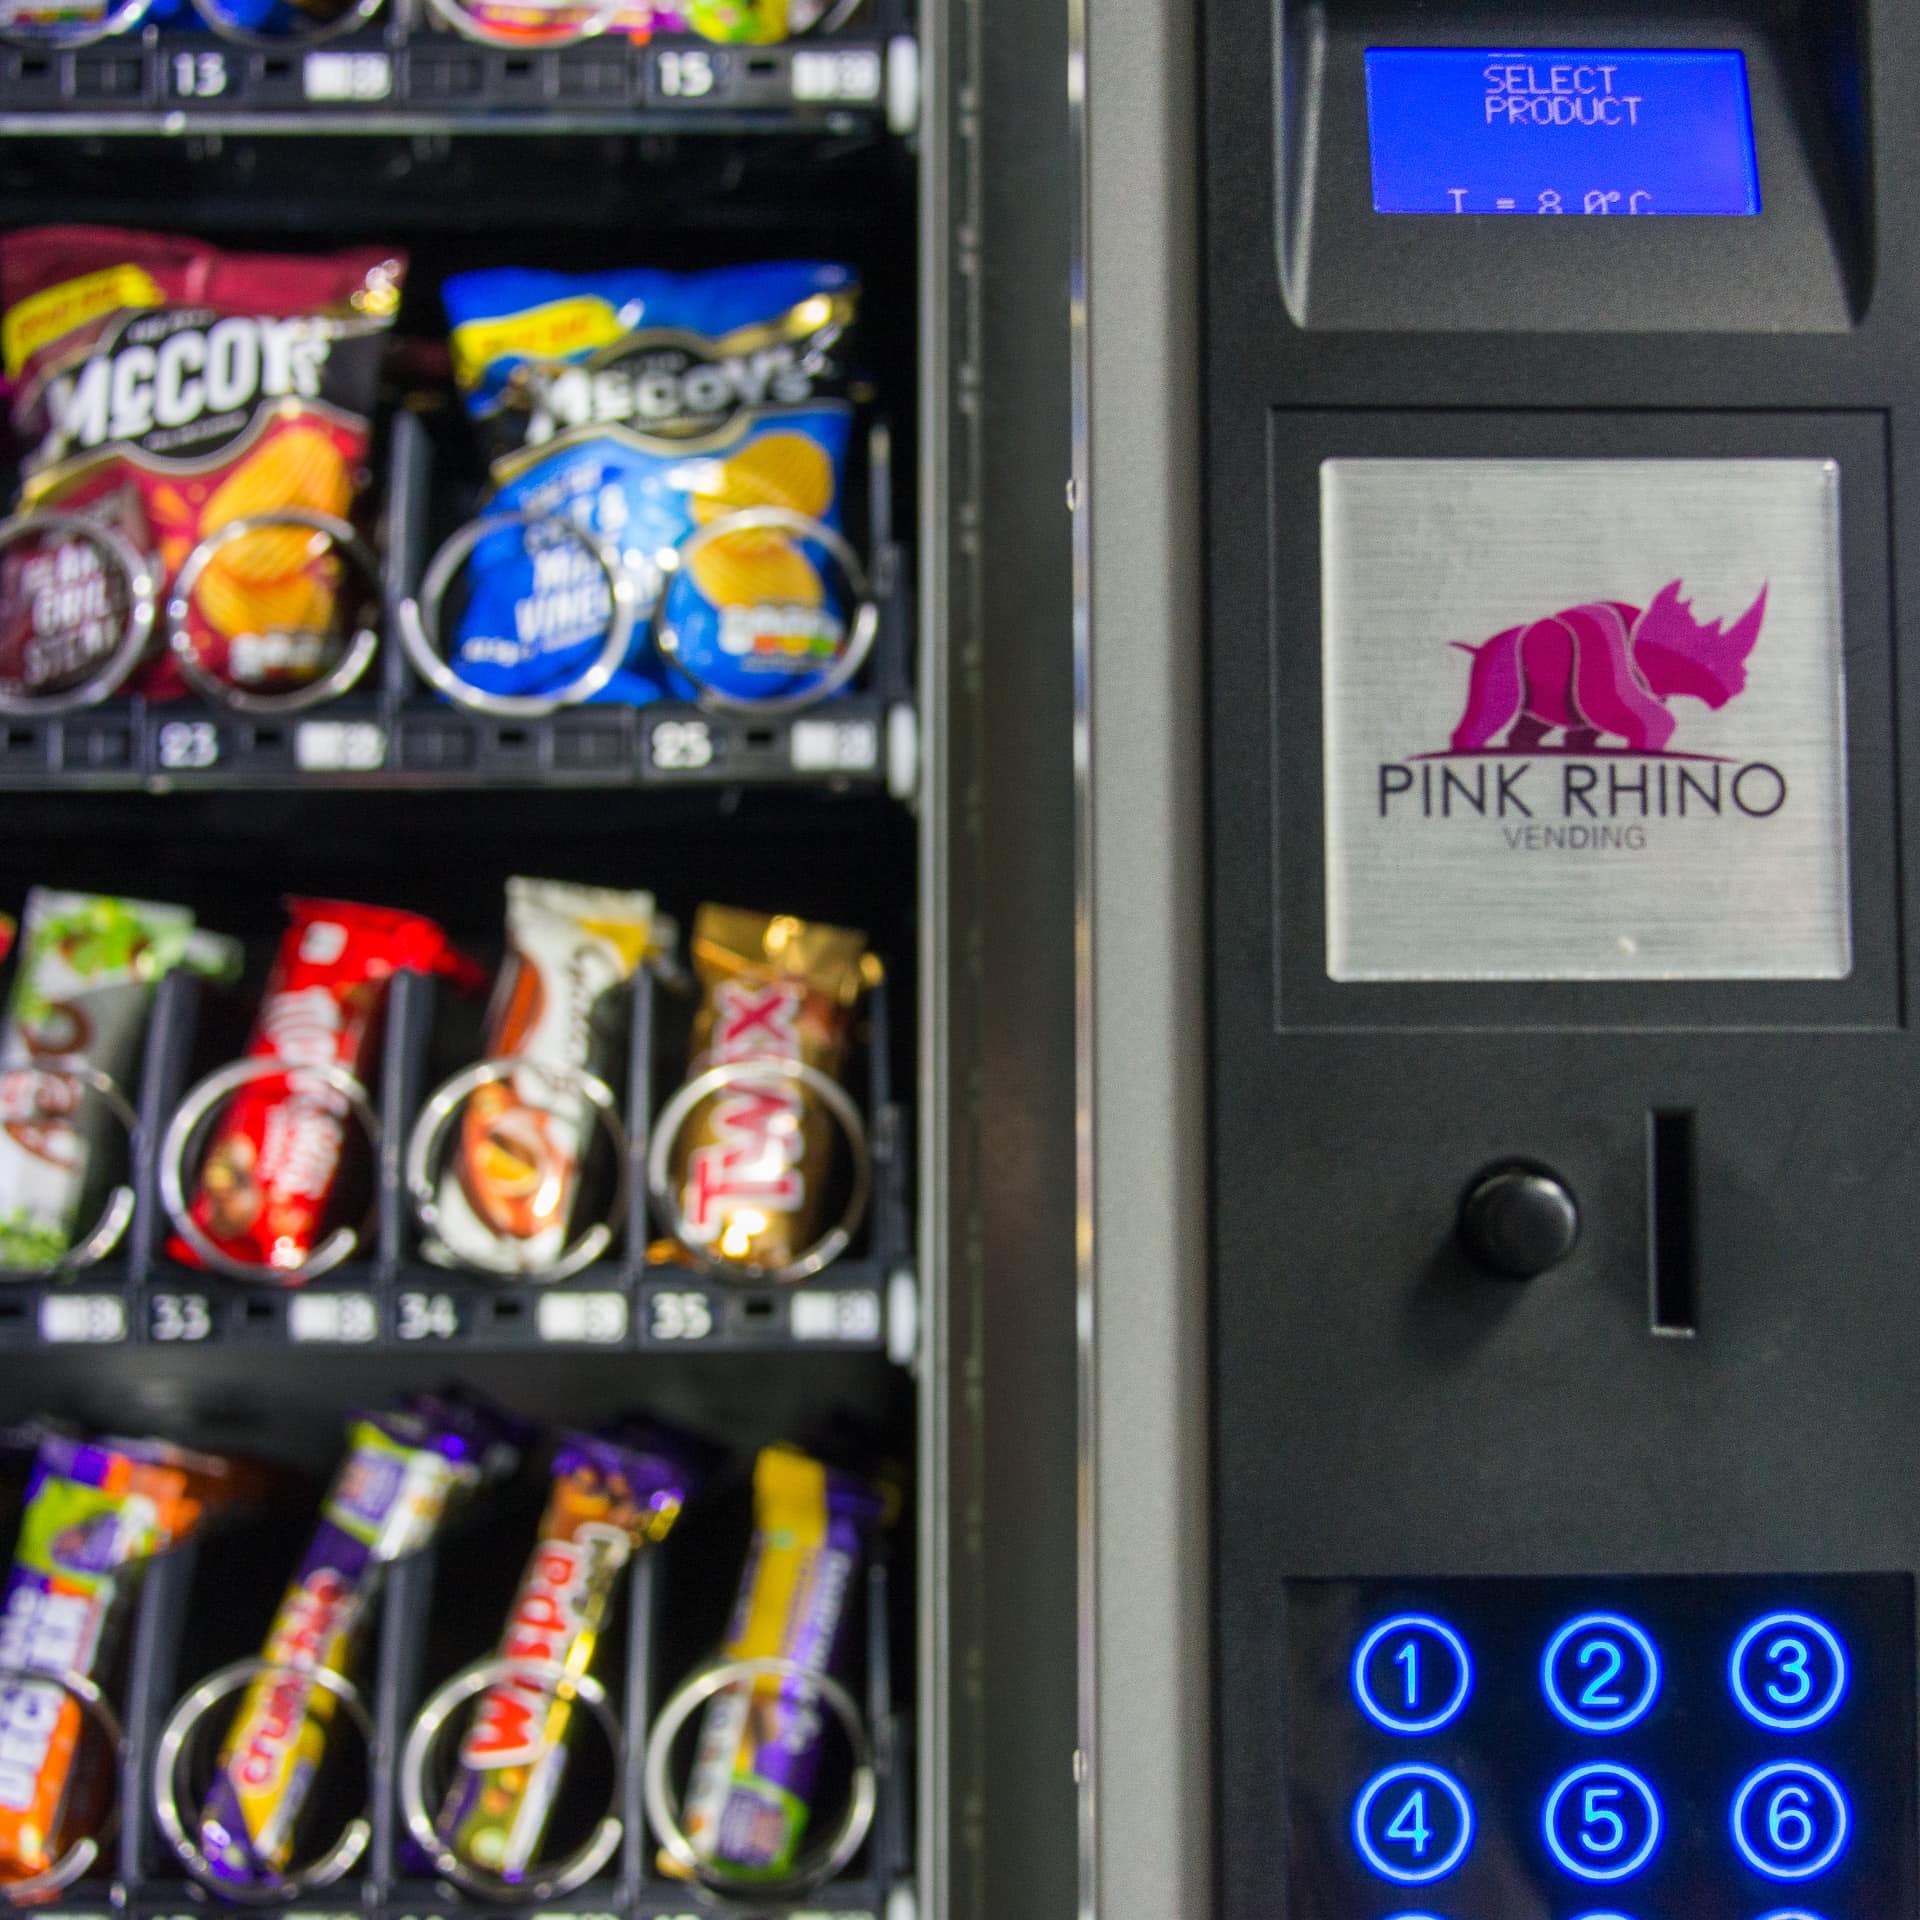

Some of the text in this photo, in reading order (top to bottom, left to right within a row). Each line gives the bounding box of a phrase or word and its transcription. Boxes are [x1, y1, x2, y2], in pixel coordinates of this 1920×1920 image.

[174, 51, 228, 97] 13
[657, 50, 714, 97] 15
[1482, 64, 1619, 95] SELECT
[1483, 95, 1644, 126] PRODUCT
[1447, 188, 1469, 214] T
[158, 720, 219, 769] 23
[651, 721, 713, 770] 25
[1378, 761, 1788, 819] PINK RHINO
[1504, 824, 1648, 852] VENDING
[150, 1294, 212, 1341] 33
[397, 1293, 460, 1341] 34
[650, 1292, 712, 1340] 35
[1397, 1638, 1811, 1705] 1 2 3
[1385, 1786, 1813, 1853] 4 5 6
